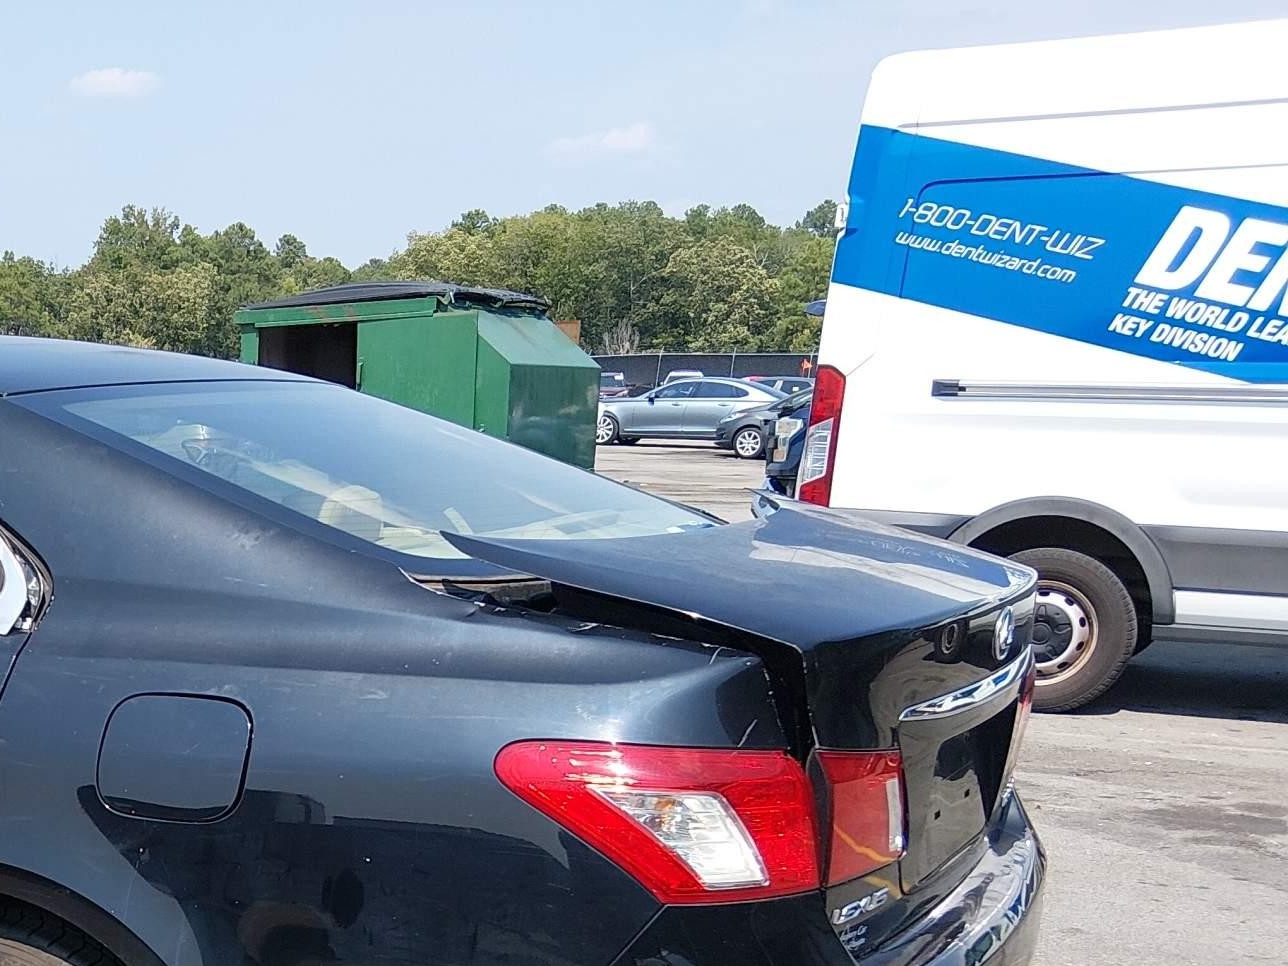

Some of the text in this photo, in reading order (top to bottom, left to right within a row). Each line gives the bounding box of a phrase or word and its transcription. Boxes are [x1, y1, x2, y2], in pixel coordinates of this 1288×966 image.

[898, 198, 1106, 260] 1-800-DENT-WIZ
[895, 230, 1077, 283] www.dentwizard.com
[1121, 286, 1170, 315] THE
[1165, 296, 1250, 333] WORLD
[1107, 313, 1245, 362] KEY DIVISION
